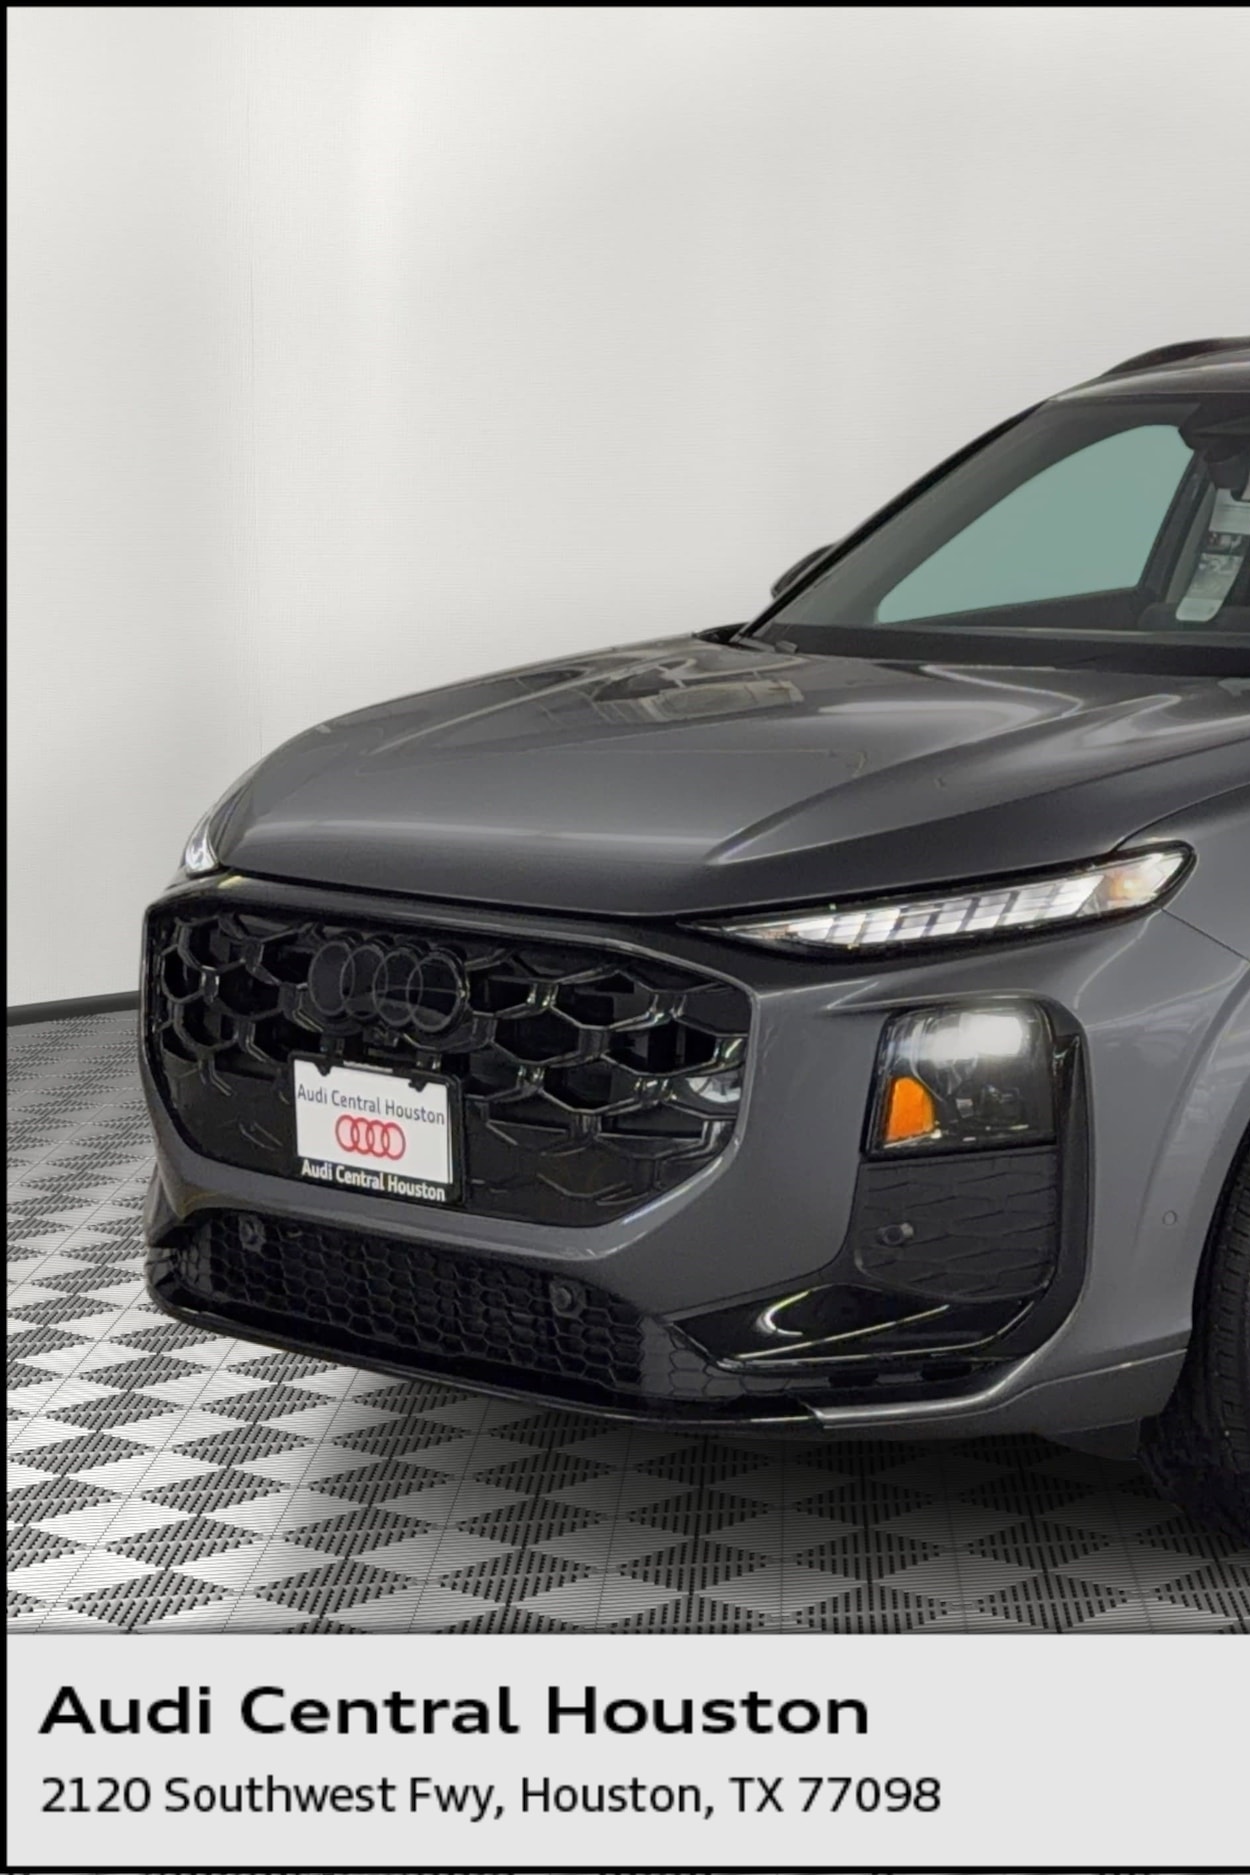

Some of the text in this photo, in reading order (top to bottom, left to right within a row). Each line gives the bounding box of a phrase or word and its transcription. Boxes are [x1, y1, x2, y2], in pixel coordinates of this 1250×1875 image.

[297, 1083, 445, 1126] Audi Central Houston
[301, 1159, 446, 1202] Audi Central Houston
